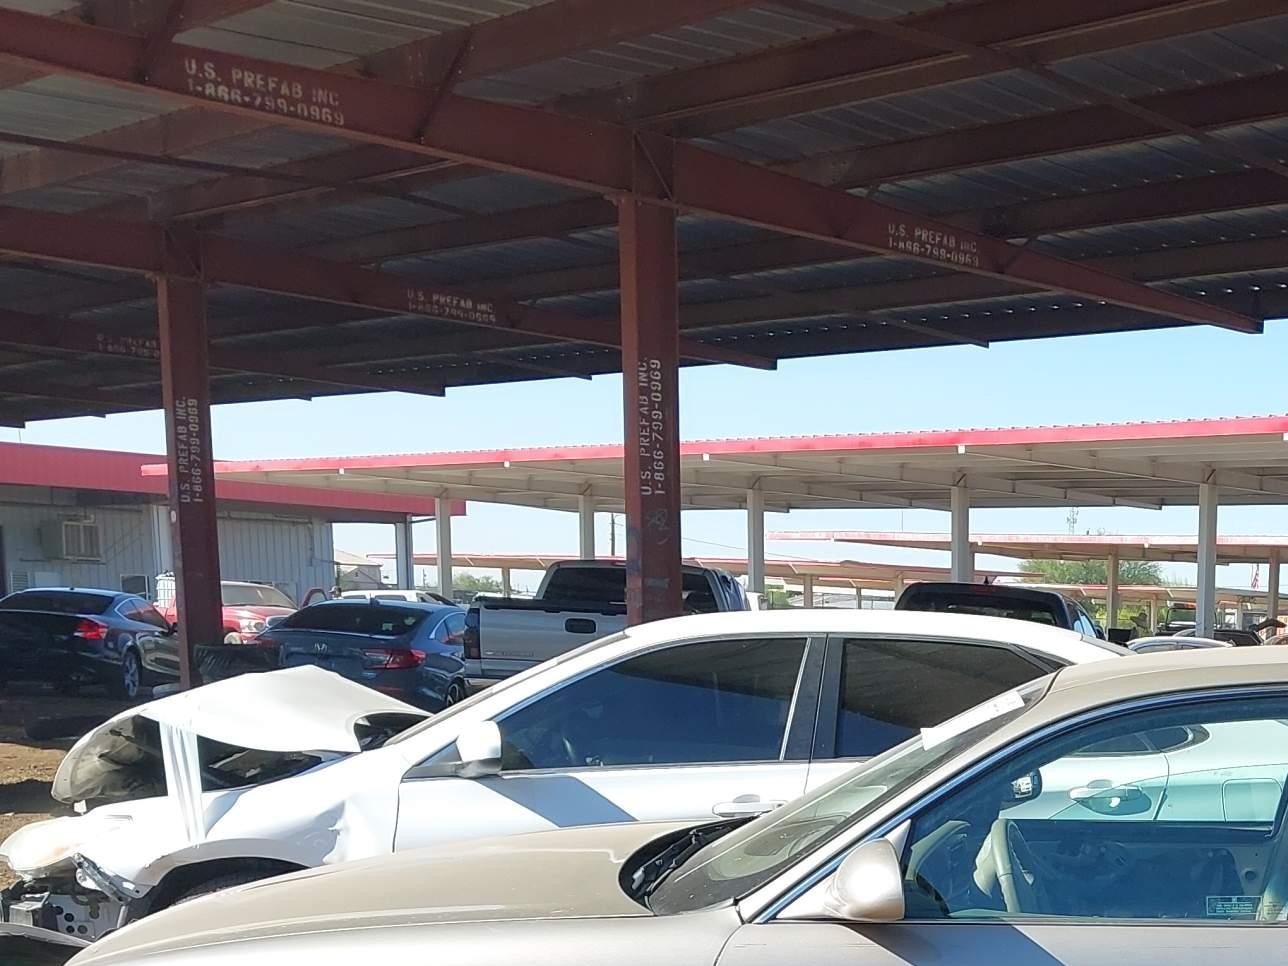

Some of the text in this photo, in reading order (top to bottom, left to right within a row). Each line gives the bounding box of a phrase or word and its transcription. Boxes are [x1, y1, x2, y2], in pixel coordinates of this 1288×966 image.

[185, 58, 222, 83] U.S.
[231, 67, 303, 99] PREFAB
[914, 227, 957, 248] PREFAB
[176, 425, 190, 473] PREFAB
[187, 398, 204, 503] 1-866-799-0969
[639, 395, 651, 458] PREFAB
[650, 359, 667, 495] 1-866-799-0969
[640, 466, 653, 496] U.S.
